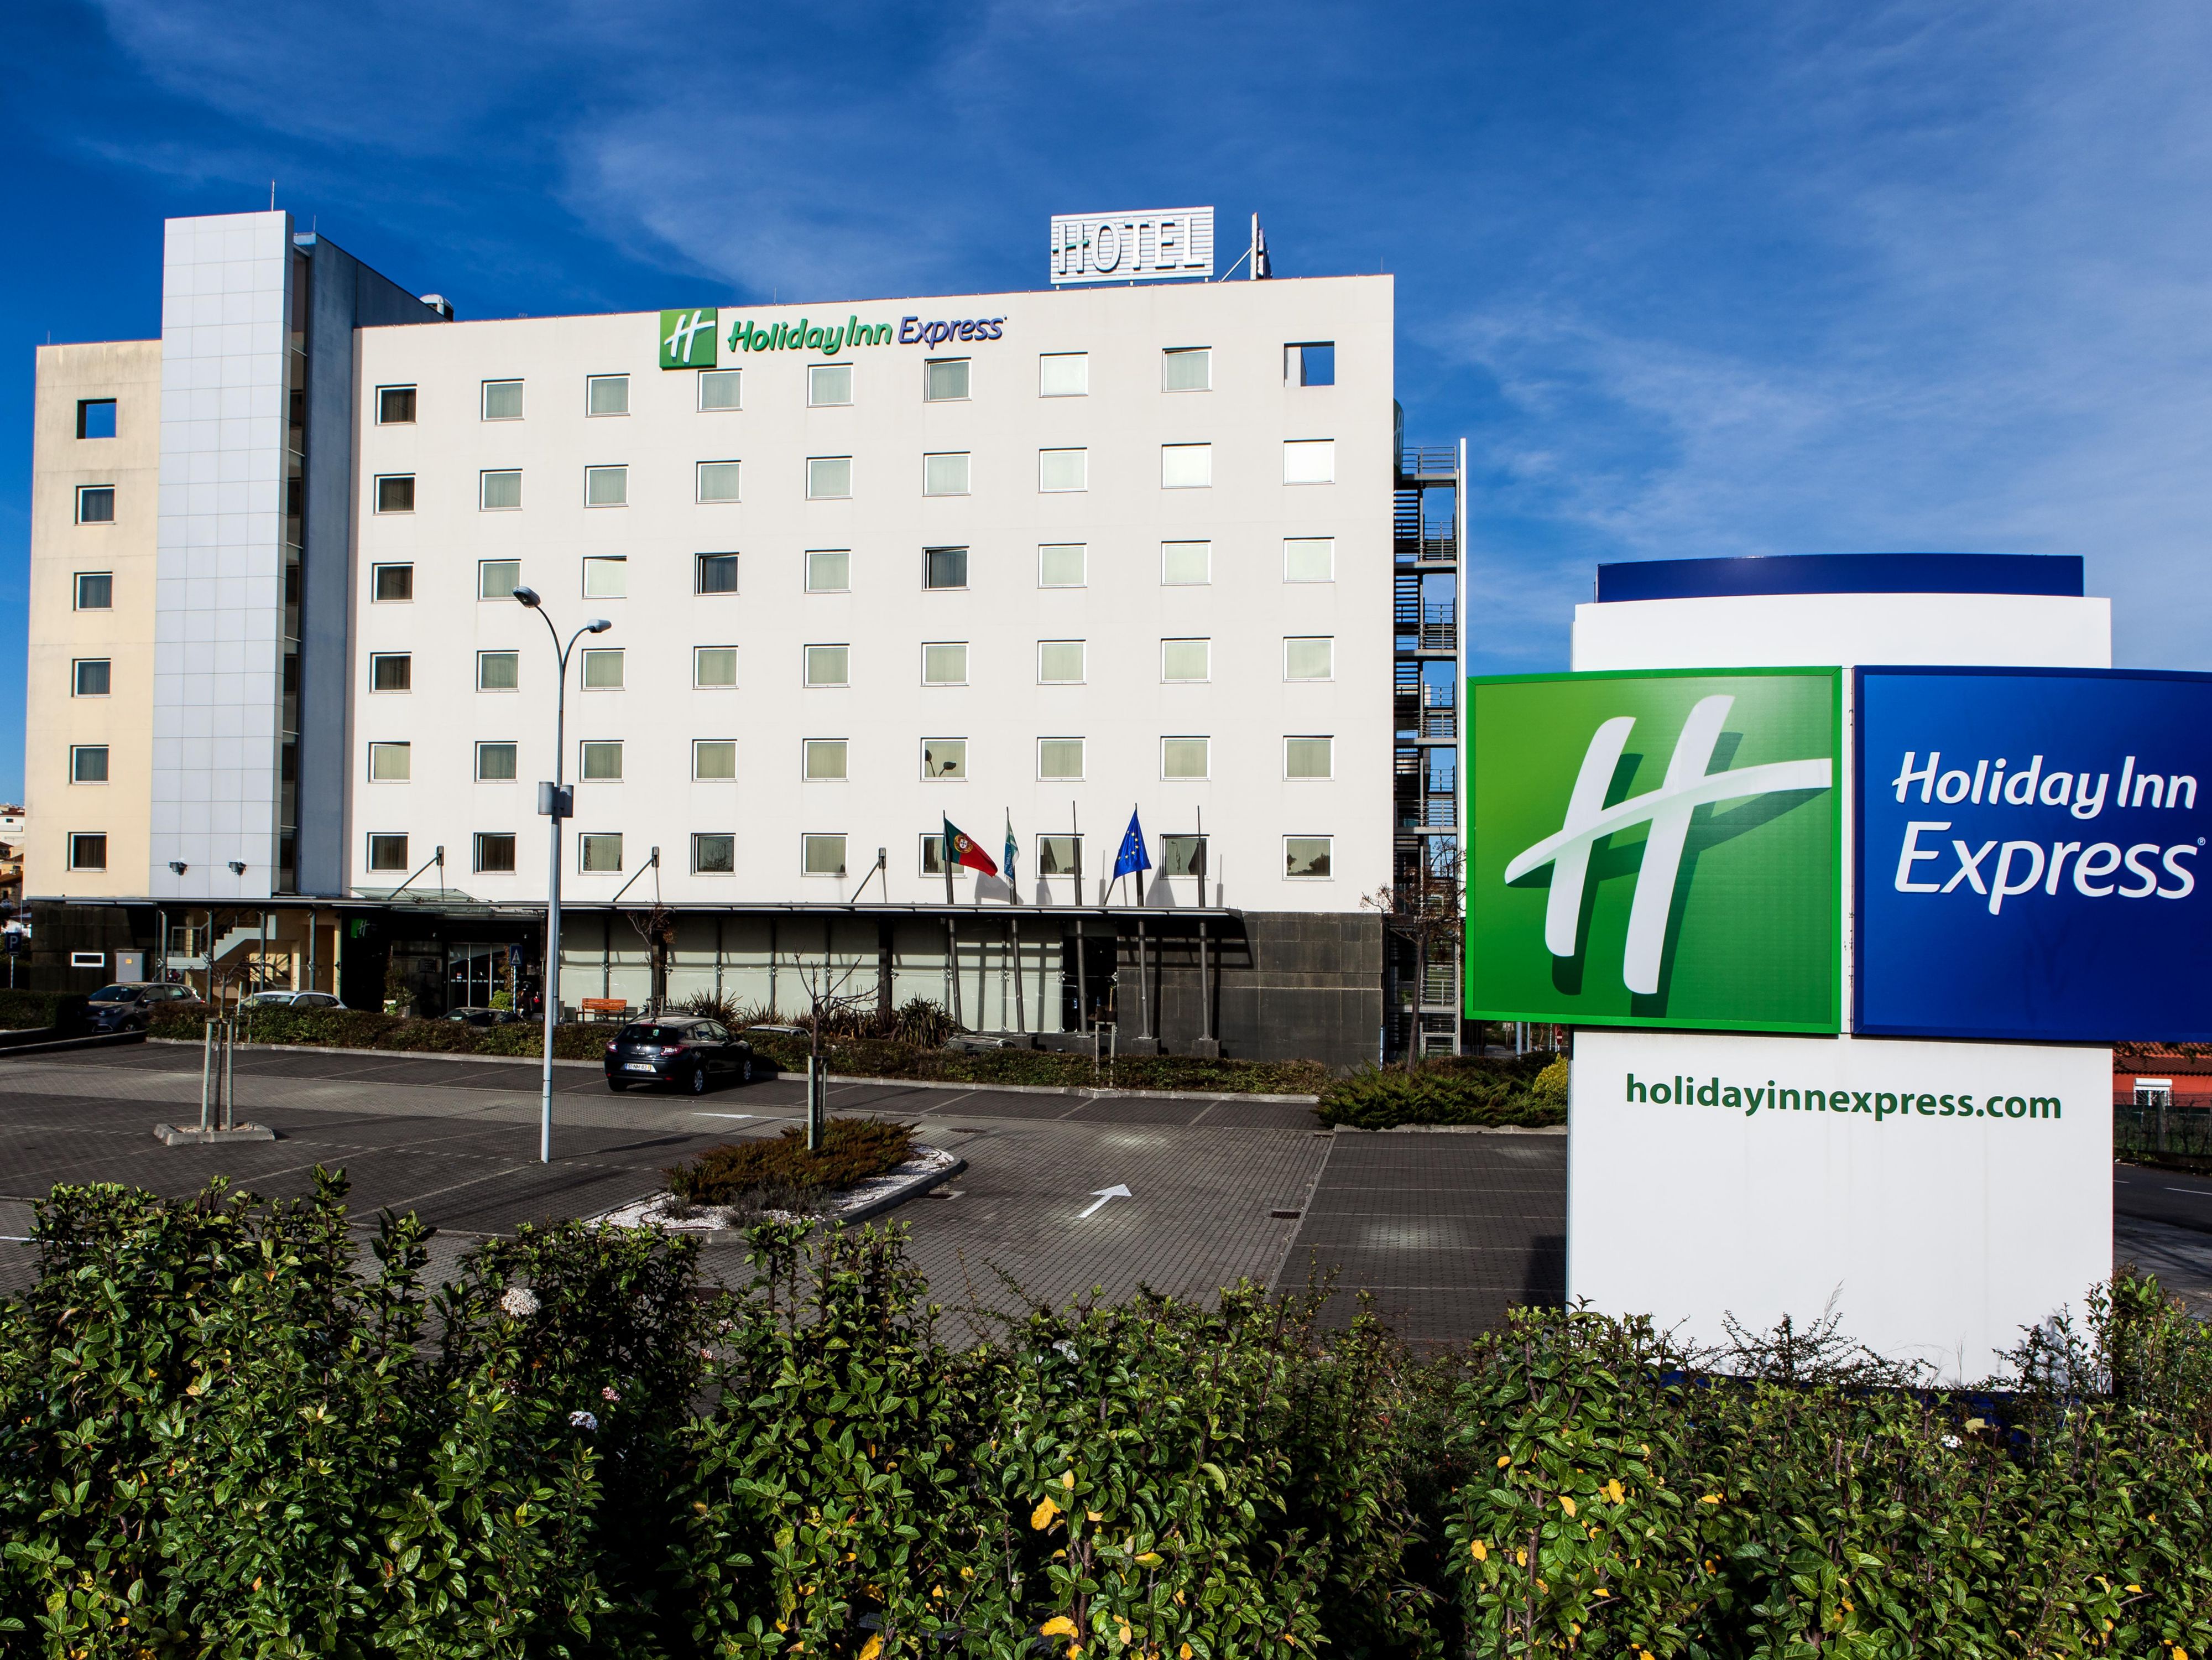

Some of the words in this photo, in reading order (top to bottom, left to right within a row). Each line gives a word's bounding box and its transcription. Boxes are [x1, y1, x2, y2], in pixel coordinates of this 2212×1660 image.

[1052, 215, 1205, 273] HOTEL
[1892, 752, 2109, 819] Holiday
[2117, 756, 2197, 809] Inn
[10, 935, 18, 949] P
[1626, 1073, 2062, 1121] holidayinnexpress.com
